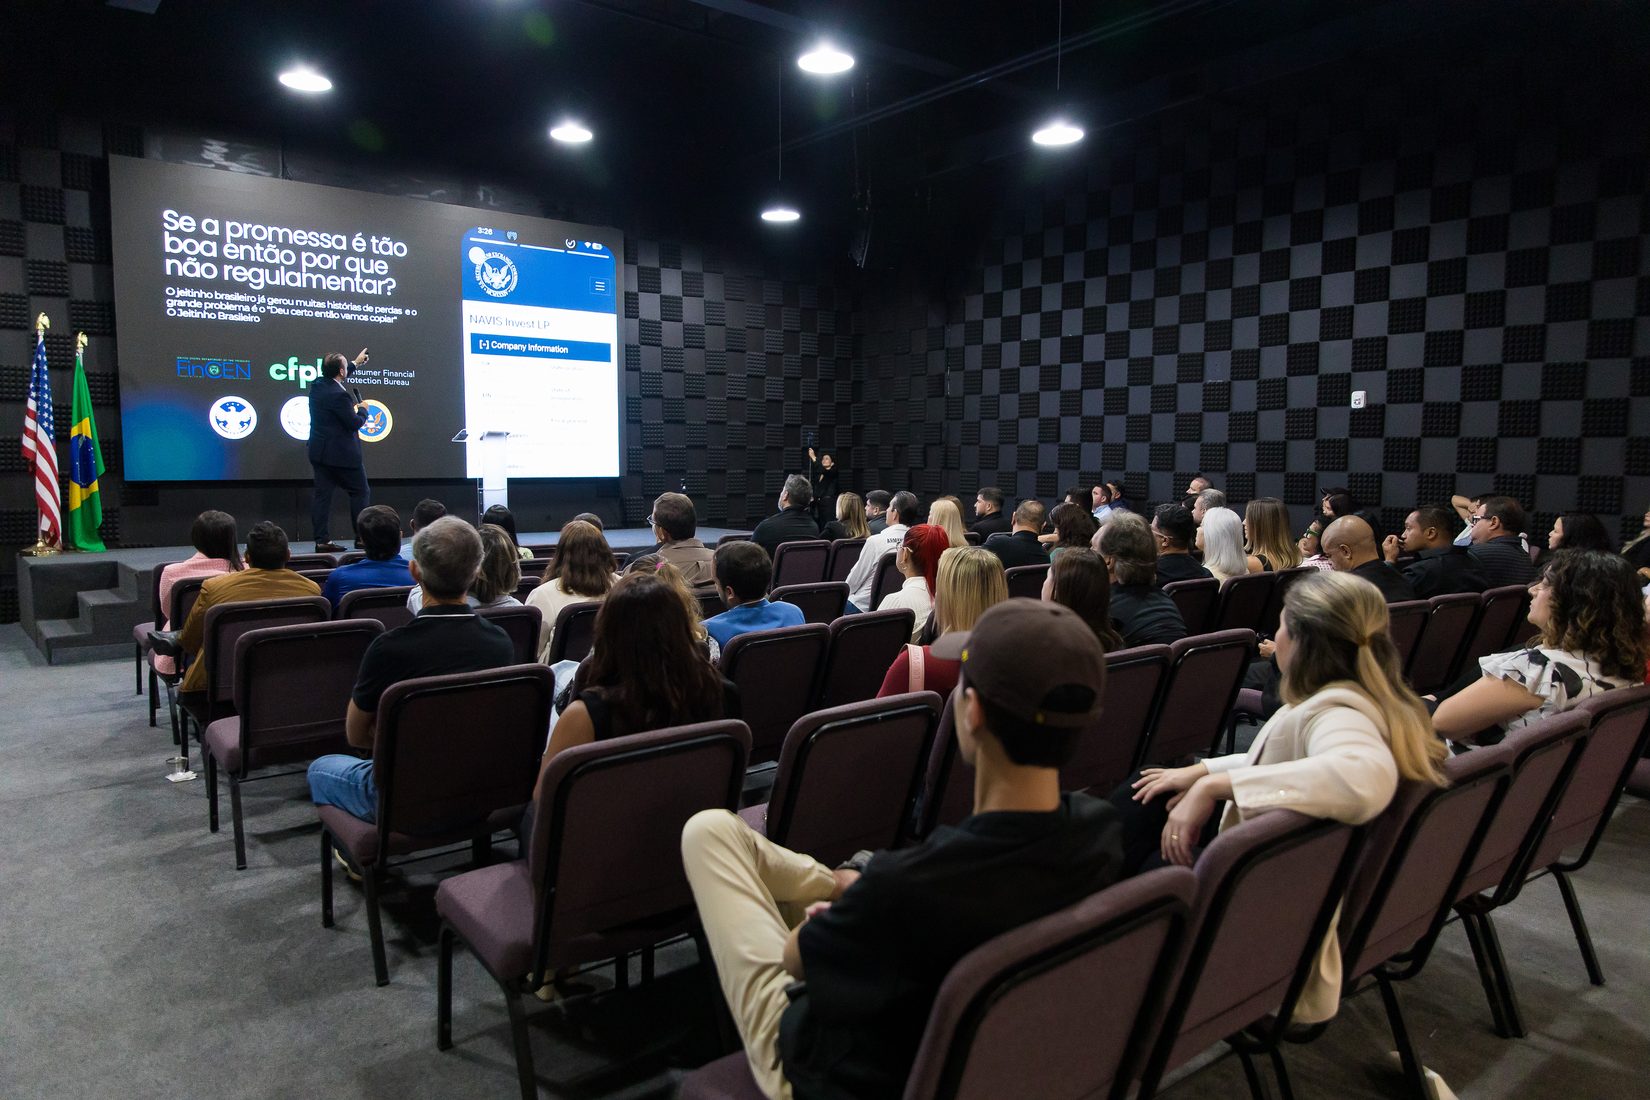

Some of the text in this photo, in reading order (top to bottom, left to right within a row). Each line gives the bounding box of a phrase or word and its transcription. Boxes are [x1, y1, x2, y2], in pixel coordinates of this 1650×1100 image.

[162, 209, 408, 257] Se a promessa é tão
[164, 230, 389, 280] boa então por que
[165, 257, 397, 296] não regulamentar?
[165, 287, 175, 296] O
[175, 287, 214, 299] jeitinho
[214, 290, 257, 303] brasileiro
[257, 294, 266, 305] já
[267, 297, 295, 307] gerou
[295, 299, 327, 310] muitas
[326, 300, 362, 312] histórias
[362, 304, 374, 313] de
[374, 306, 403, 315] perdas
[411, 309, 418, 317] o
[166, 298, 203, 309] grande
[203, 301, 250, 312] problema
[251, 304, 258, 313] é
[258, 306, 266, 314] o
[266, 306, 290, 315] "Deu
[290, 308, 314, 317] certo
[314, 310, 340, 319] então
[340, 312, 370, 322] vamos
[166, 308, 261, 323] O Jeitinho Brasileiro
[469, 314, 550, 330] NAVIS Invest LP
[490, 340, 527, 353] Company
[527, 343, 569, 354] Information
[176, 359, 251, 379] FinCEN
[352, 369, 415, 378] nsumer Financial
[346, 376, 410, 386] rotection Bureau
